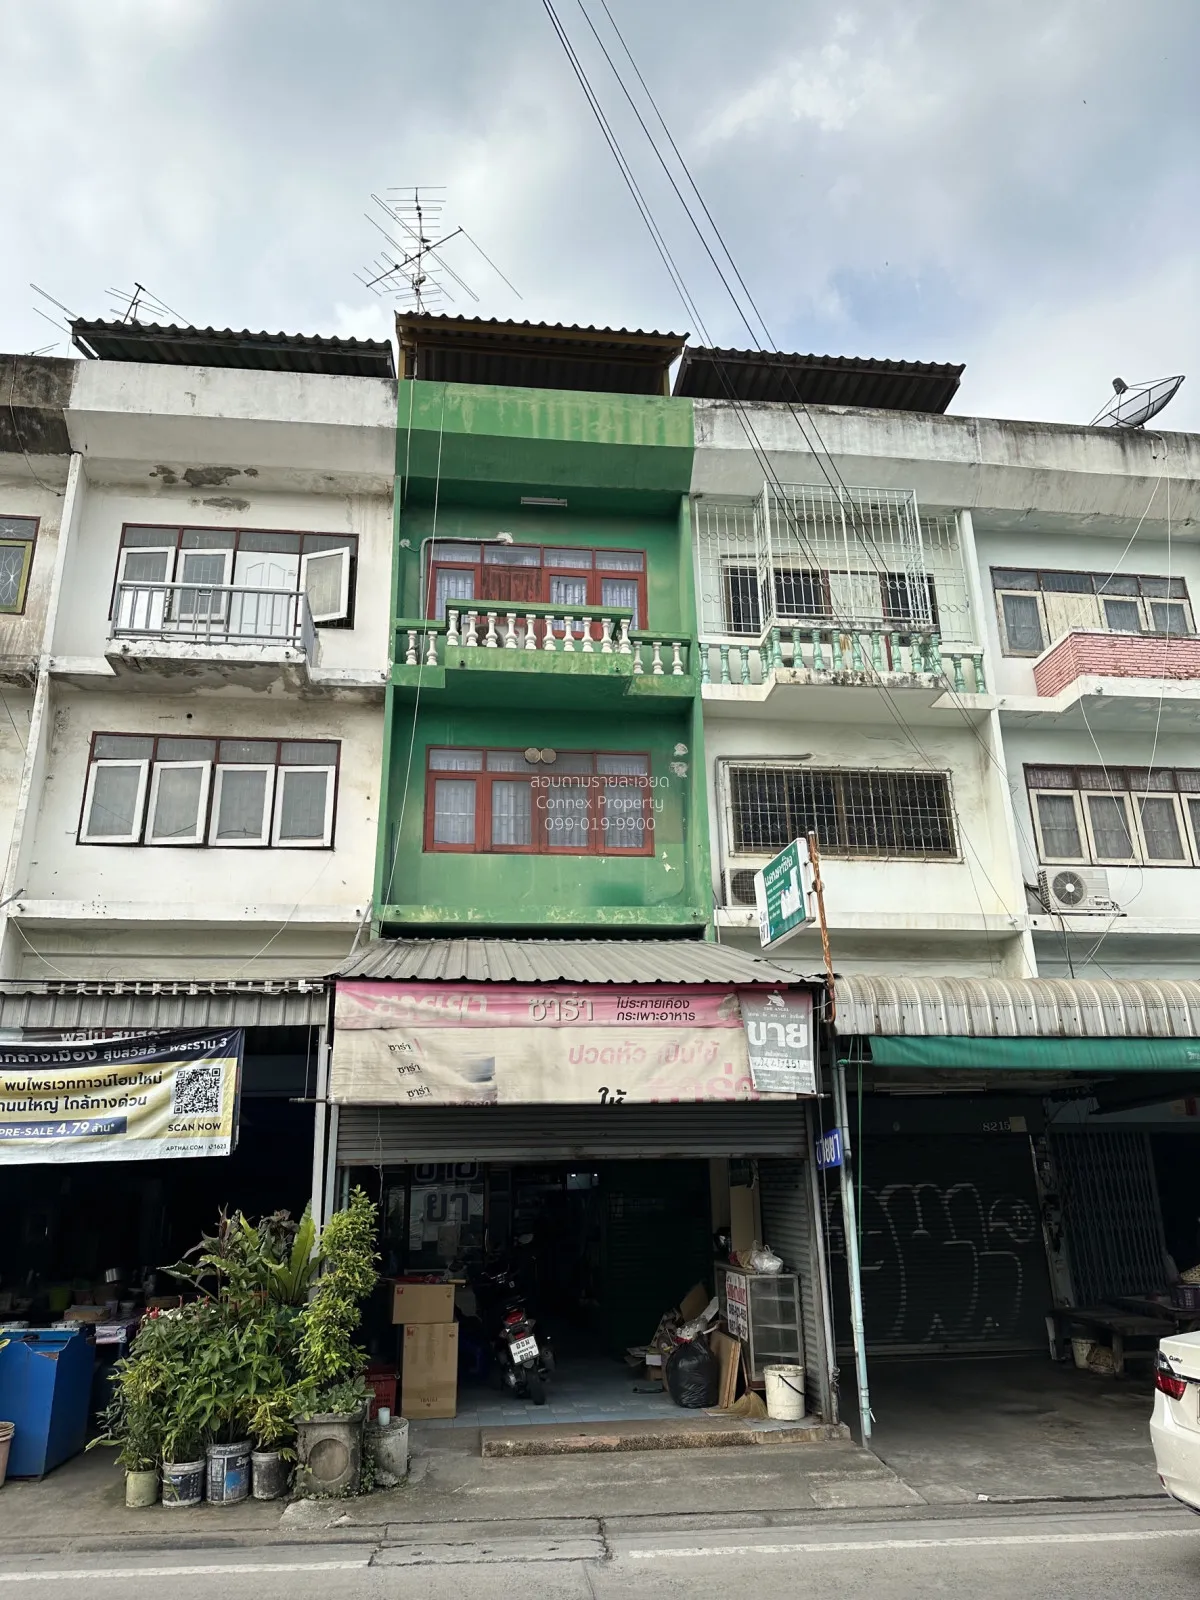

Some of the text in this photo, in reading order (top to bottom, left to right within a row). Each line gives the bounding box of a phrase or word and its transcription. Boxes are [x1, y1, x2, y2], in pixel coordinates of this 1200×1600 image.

[616, 996, 691, 1010] ไม่ระคายเคือง
[616, 1011, 697, 1022] กระเพาะอาหาร
[746, 1021, 809, 1049] ขาย
[0, 1050, 97, 1063] กลางเมือง
[220, 1037, 227, 1048] 3
[568, 1040, 648, 1064] ปวดหัว
[63, 1093, 147, 1111] ใกล้ทางด่วน
[56, 1121, 90, 1135] 4.79
[168, 1122, 222, 1132] SCAN NOW
